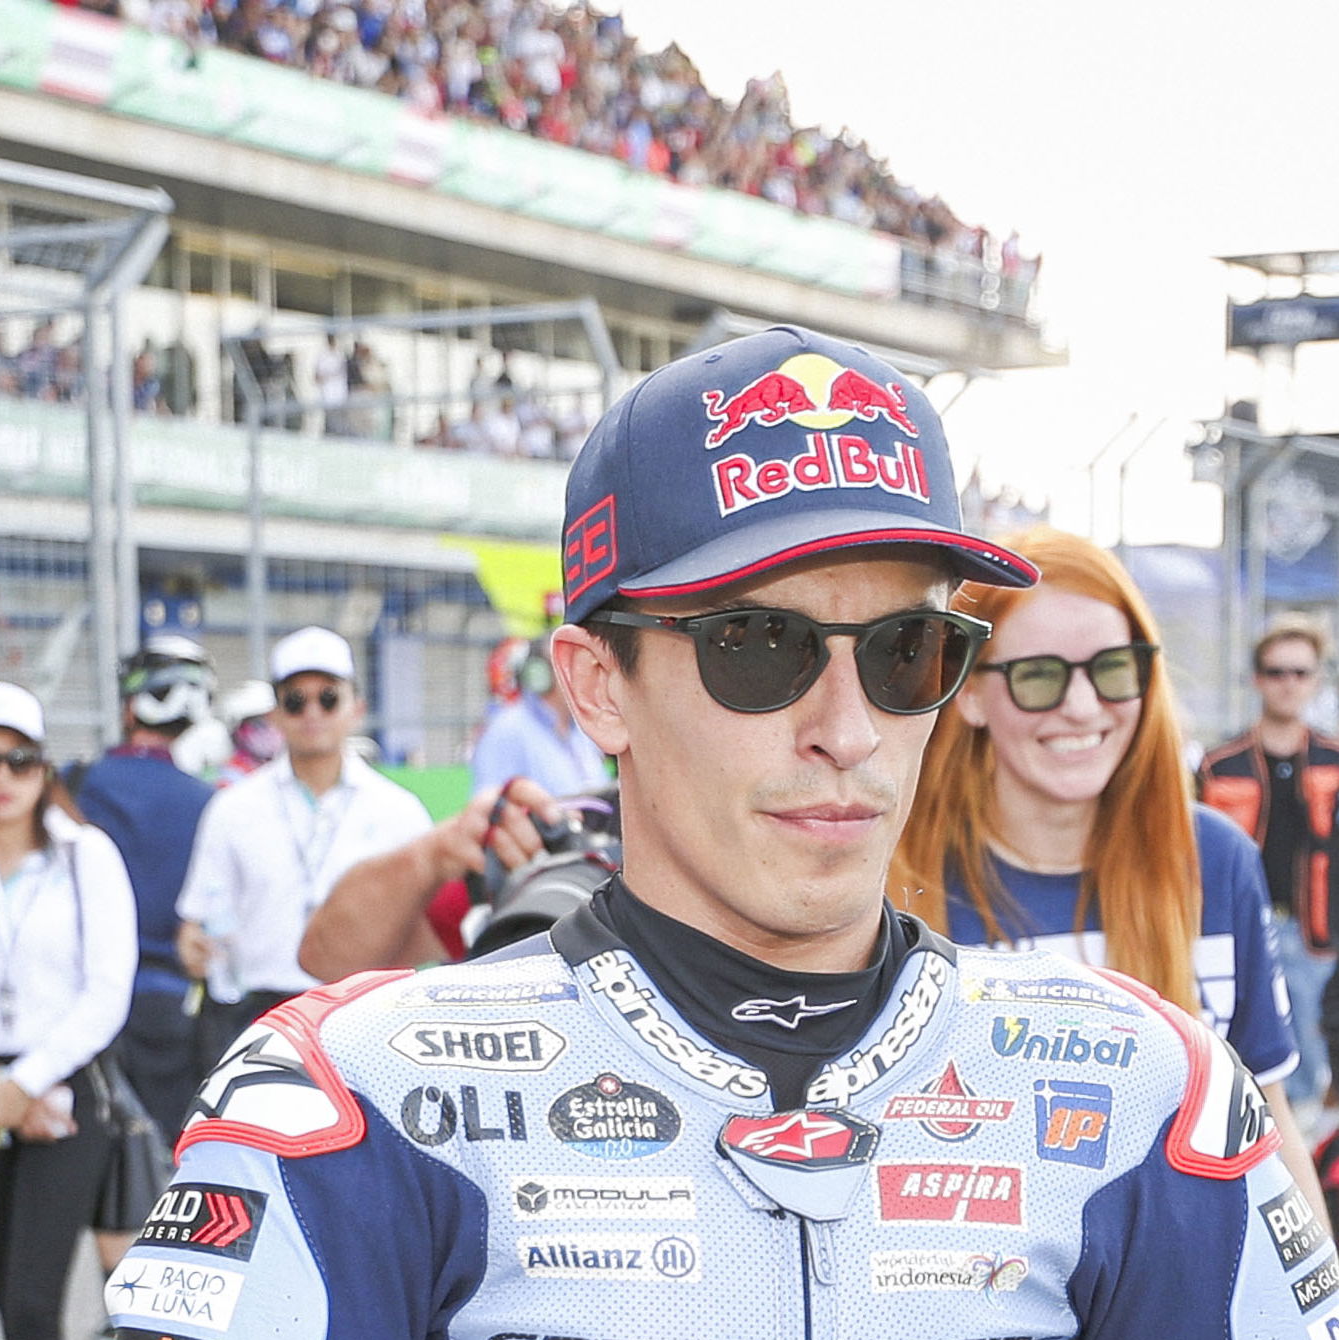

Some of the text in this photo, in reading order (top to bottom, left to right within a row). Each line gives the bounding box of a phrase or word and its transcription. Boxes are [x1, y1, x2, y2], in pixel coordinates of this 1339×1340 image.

[713, 432, 930, 516] Red Bull
[587, 952, 767, 1098] alpinestars
[807, 953, 950, 1106] alpinestars
[415, 1030, 544, 1062] SHOEI
[991, 1016, 1139, 1069] Unibat
[568, 1098, 658, 1120] Estrella
[890, 1099, 1005, 1118] FEDERAL OIL
[572, 1116, 657, 1138] Galicia
[1044, 1107, 1108, 1151] IP
[553, 1188, 692, 1201] MODULA
[900, 1172, 1013, 1202] ASPIRA
[145, 1190, 203, 1224] OLD
[527, 1242, 643, 1270] Allianz
[876, 1268, 973, 1288] indonesia
[151, 1293, 213, 1321] LUNA
